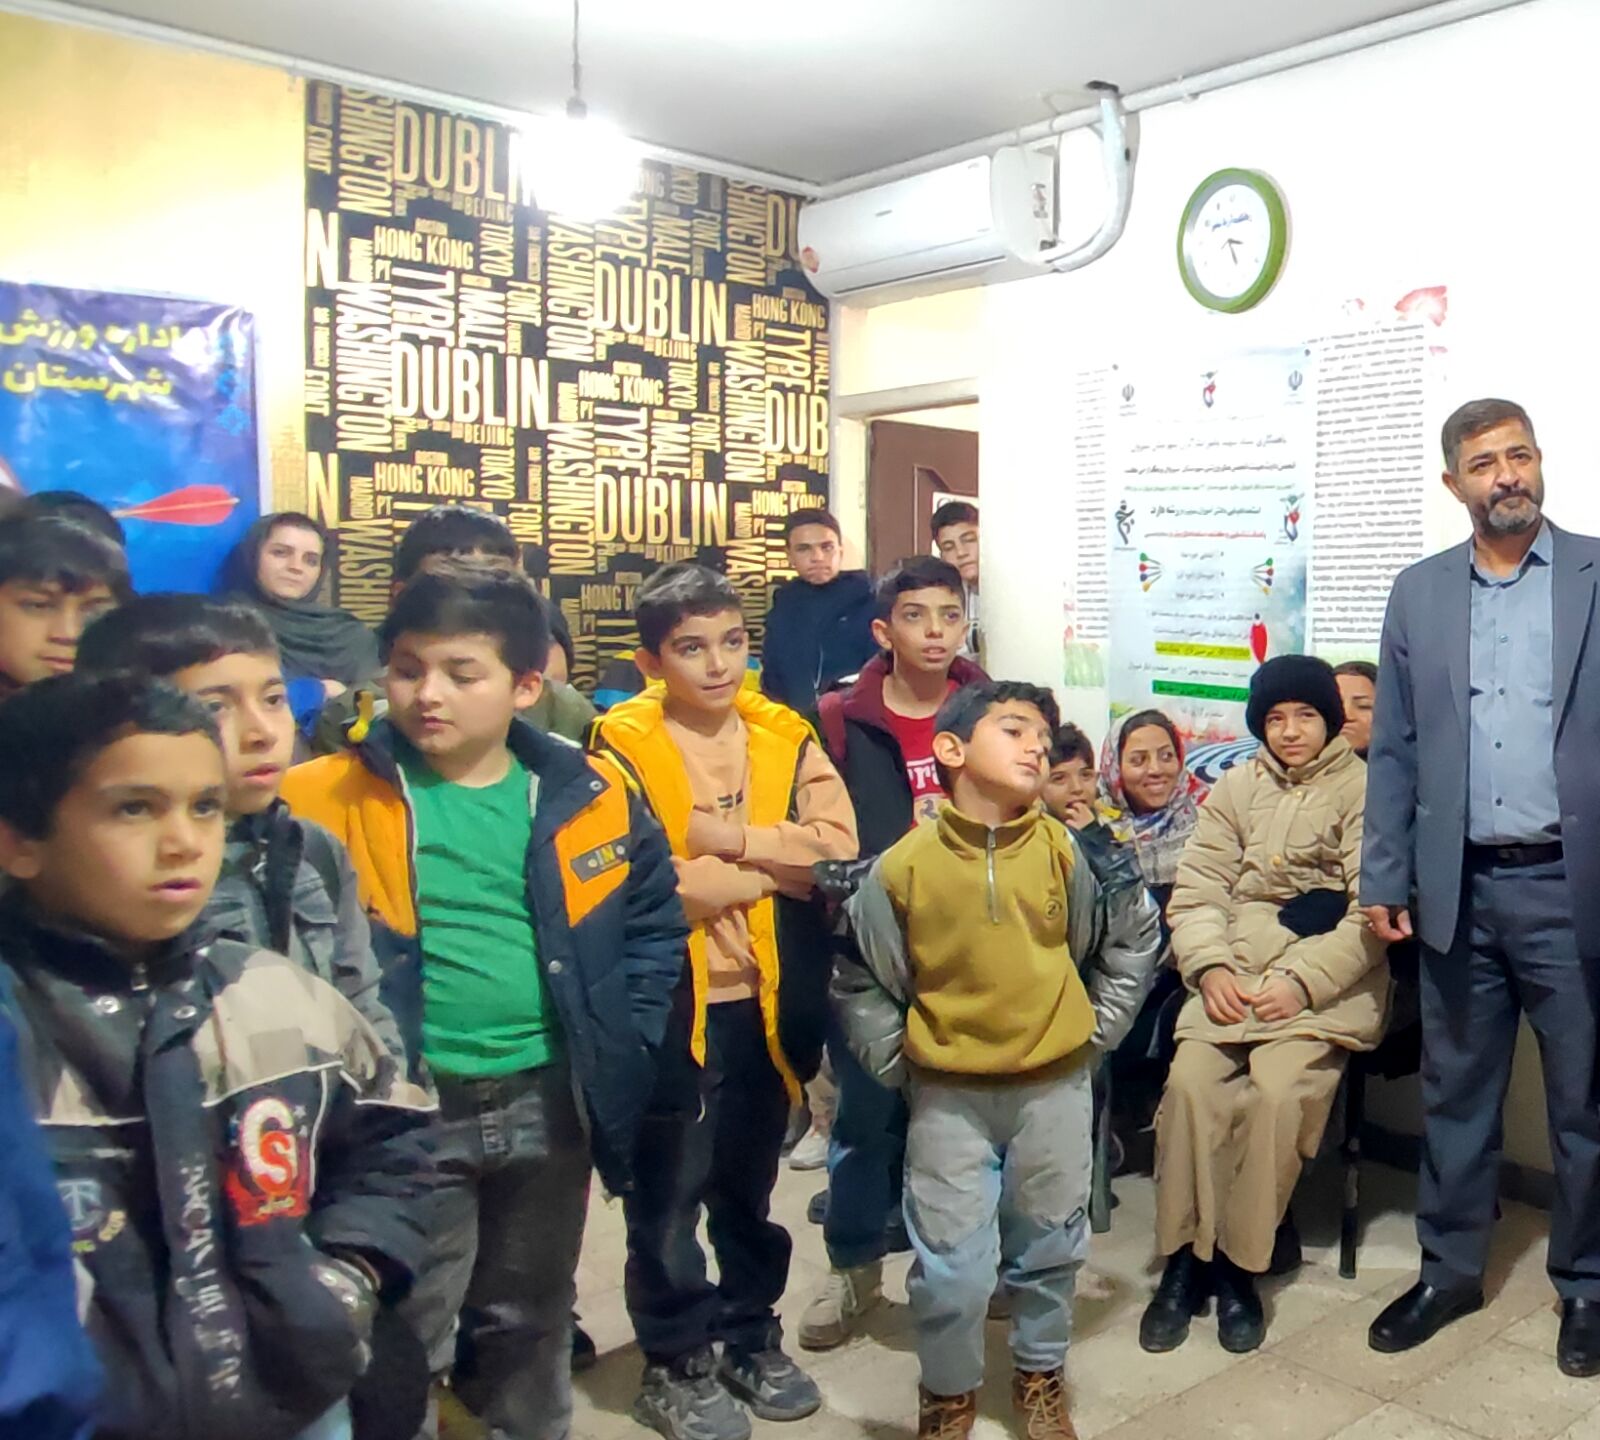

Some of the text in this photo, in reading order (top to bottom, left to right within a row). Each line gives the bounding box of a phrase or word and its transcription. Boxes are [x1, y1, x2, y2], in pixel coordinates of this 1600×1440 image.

[374, 224, 423, 263] HONG
[425, 235, 474, 270] KONG
[480, 222, 514, 278] TOKYO
[0, 308, 98, 350] ورزش
[392, 267, 456, 347] TYPE
[459, 287, 506, 354] MALE
[507, 280, 542, 328] FONT
[594, 260, 728, 348] DUBLIN
[752, 293, 825, 330] HONG KONG
[3, 361, 174, 401] شهرستان
[336, 281, 393, 453] WASHINGTON
[391, 340, 549, 431] DUBLIN
[668, 361, 698, 410] TOKYO
[765, 327, 811, 394] TYPE
[578, 370, 664, 406] HONG KONG
[724, 341, 766, 483] WASHINGTON
[464, 423, 515, 447] BEIJING
[594, 407, 648, 477] TYPE
[651, 421, 691, 480] MALE
[691, 412, 722, 453] FONT
[374, 461, 475, 497] HONG KONG
[480, 448, 515, 500] TOKYO
[547, 422, 596, 576] WASHINGTON
[508, 502, 543, 547] FONT
[594, 473, 728, 549] DUBLIN
[752, 489, 788, 517] HONG
[581, 584, 622, 612] HONG
